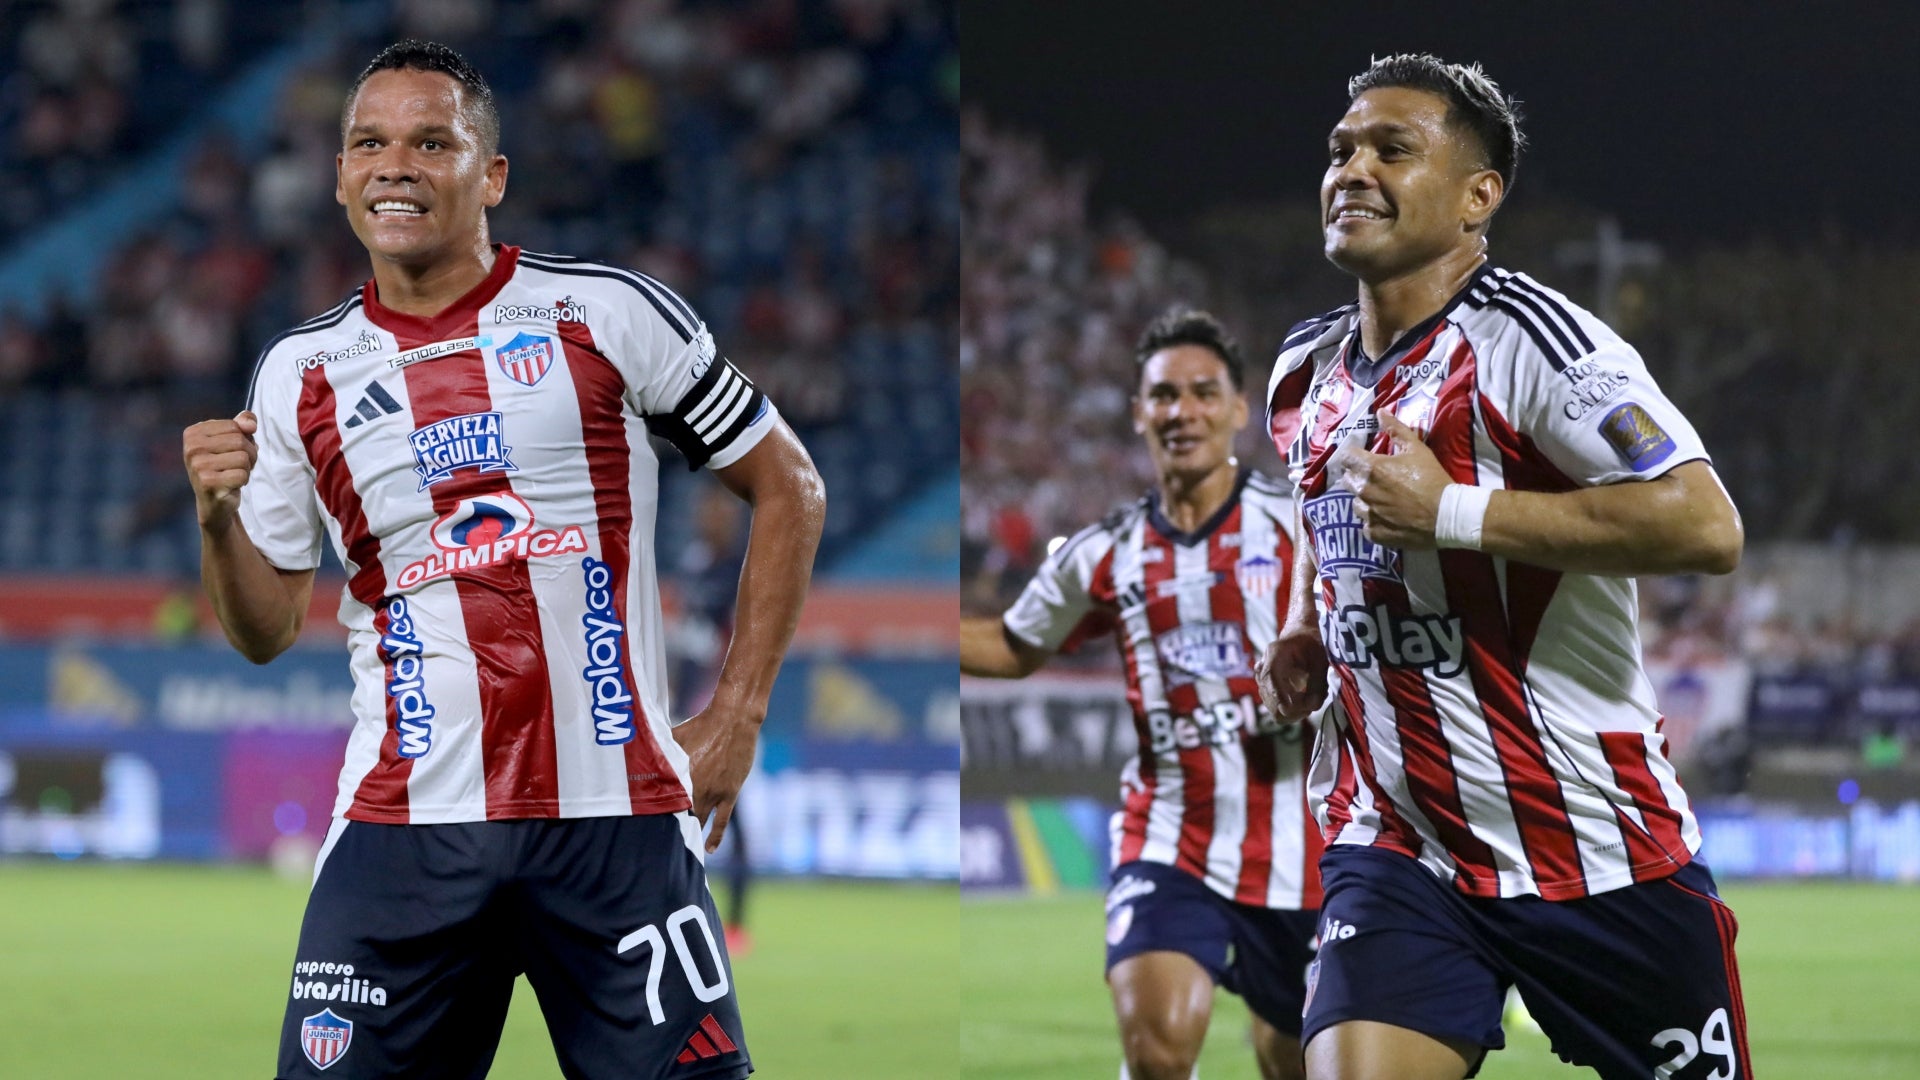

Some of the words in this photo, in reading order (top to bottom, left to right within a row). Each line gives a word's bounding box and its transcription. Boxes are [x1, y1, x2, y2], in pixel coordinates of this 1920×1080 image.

[506, 347, 546, 363] JUNIOR
[1563, 370, 1630, 421] CALDAS
[421, 436, 501, 476] AGUILA
[399, 527, 587, 589] OLIMPICA
[1316, 527, 1386, 565] AGUILA
[583, 562, 635, 744] wplay.co
[382, 597, 435, 757] wplay.co
[295, 961, 355, 977] expreso
[617, 904, 729, 1026] 70
[292, 976, 387, 1007] brasilia
[308, 1030, 342, 1040] JUNIOR
[1650, 1007, 1737, 1080] 29
